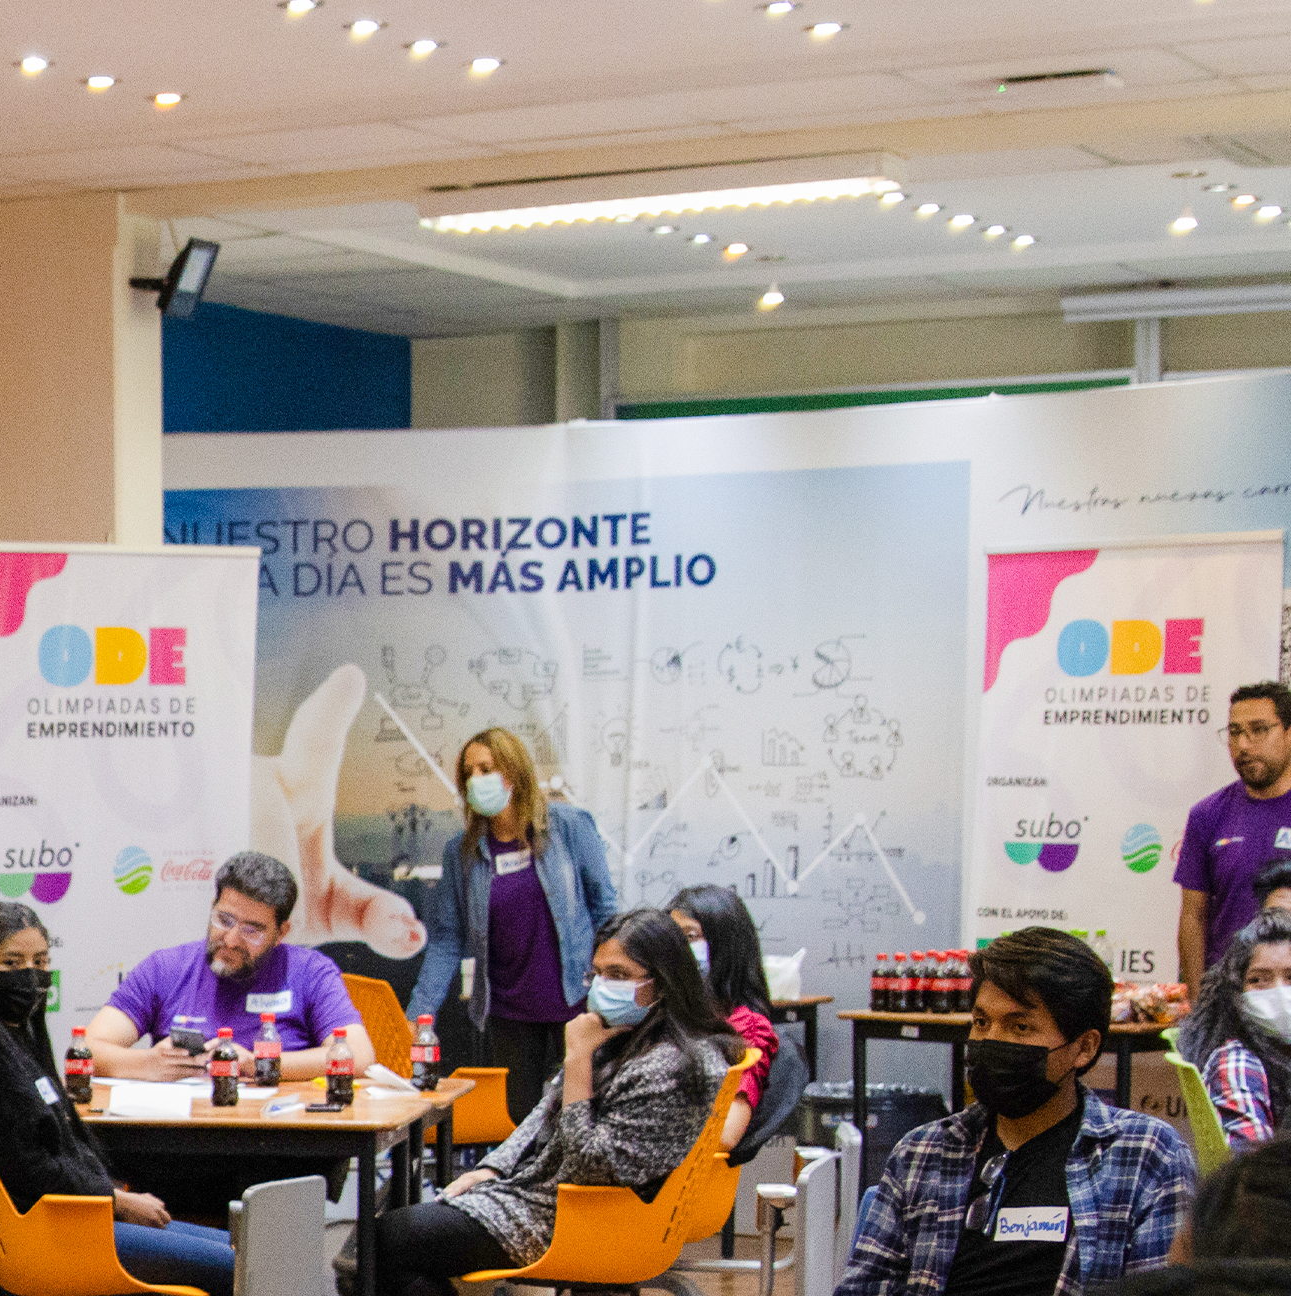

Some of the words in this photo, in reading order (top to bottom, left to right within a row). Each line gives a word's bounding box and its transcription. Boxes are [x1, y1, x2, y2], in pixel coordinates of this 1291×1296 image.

[389, 512, 651, 552] HORIZONTE
[381, 561, 433, 597] ES
[448, 549, 546, 594] MÁS
[556, 553, 717, 593] AMPLIO
[38, 624, 187, 687] ODE
[1057, 618, 1204, 677] ODE
[27, 697, 161, 715] OLIMPIADAS
[169, 697, 196, 715] DE
[1044, 685, 1175, 704] OLIMPIADAS
[1186, 684, 1212, 703] DE
[27, 721, 196, 739] EMPRENDIMIENTO
[1043, 708, 1210, 726] EMPRENDIMIENTO
[1014, 812, 1083, 839] subo
[3, 839, 74, 869] subo
[976, 907, 1000, 918] CON
[1001, 907, 1014, 918] EL
